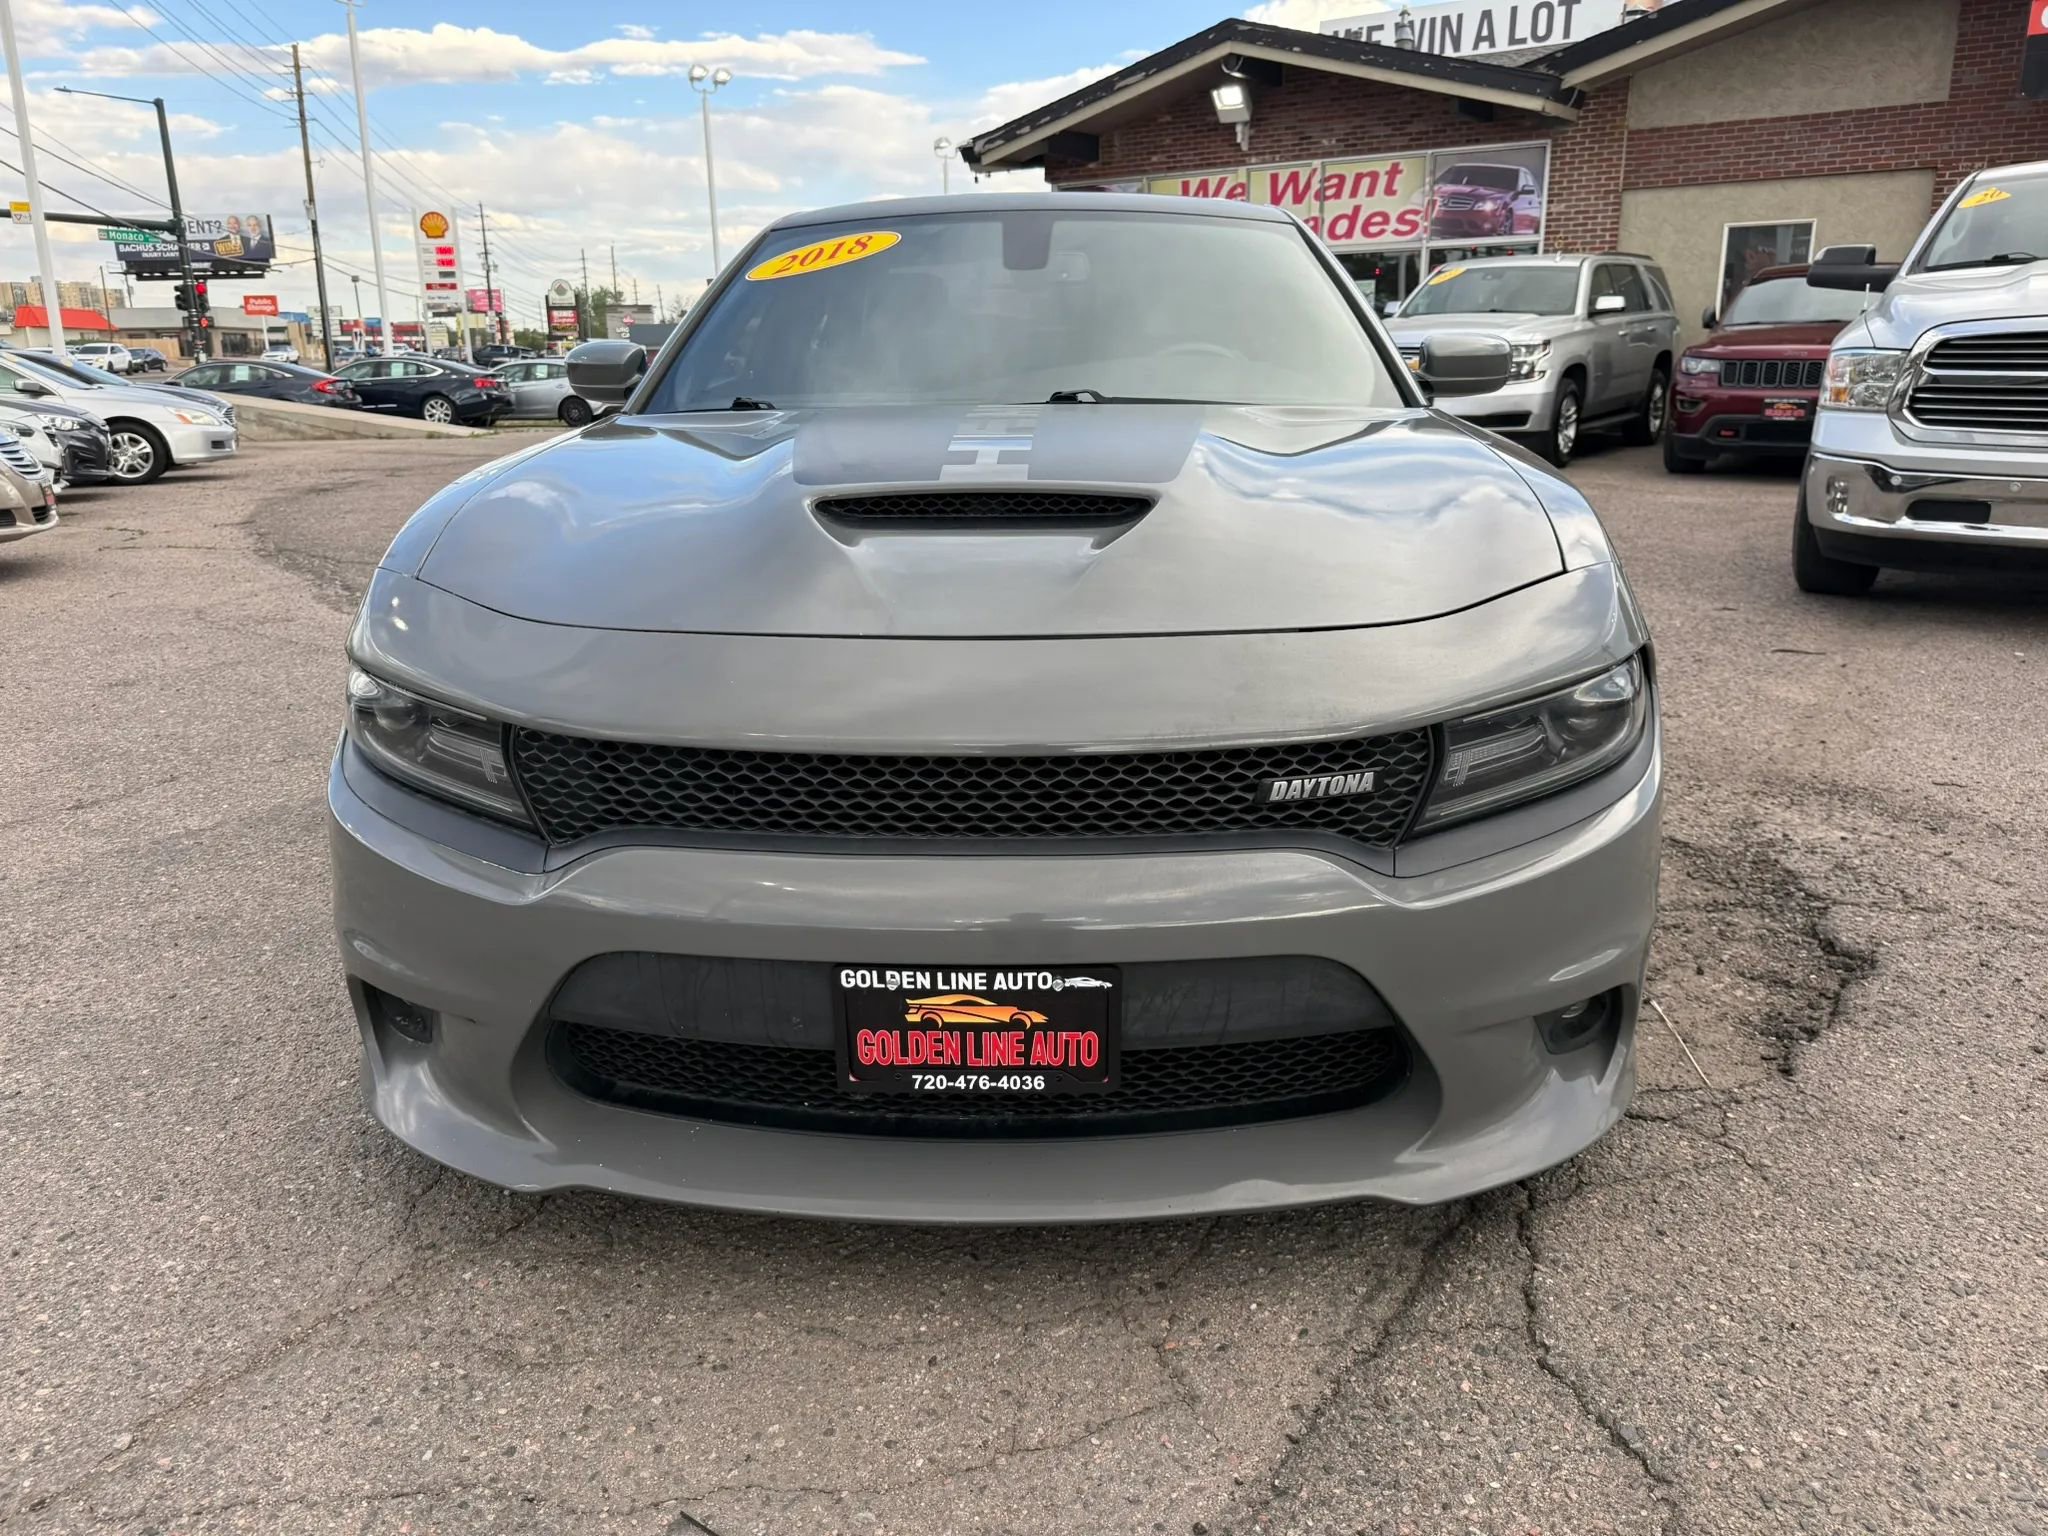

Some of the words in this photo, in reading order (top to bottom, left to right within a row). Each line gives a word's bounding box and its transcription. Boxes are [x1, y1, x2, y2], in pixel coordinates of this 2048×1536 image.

[1472, 9, 1494, 51] A
[1508, 0, 1581, 45] LOT
[1268, 161, 1404, 206] Want
[108, 230, 144, 242] Monaco
[1302, 198, 1440, 243] ades!
[119, 243, 154, 252] BACHUS
[156, 242, 201, 252] SCHAER
[771, 235, 873, 275] 2018
[1268, 771, 1376, 801] DAYTONA
[840, 968, 931, 991] GOLDEN
[936, 971, 987, 990] LINE
[993, 971, 1053, 990] AUTO
[856, 1028, 961, 1066] GOLDEN
[966, 1031, 1025, 1067] LINE
[1029, 1030, 1099, 1068] AUTO
[911, 1074, 1045, 1091] 720-476-4036
